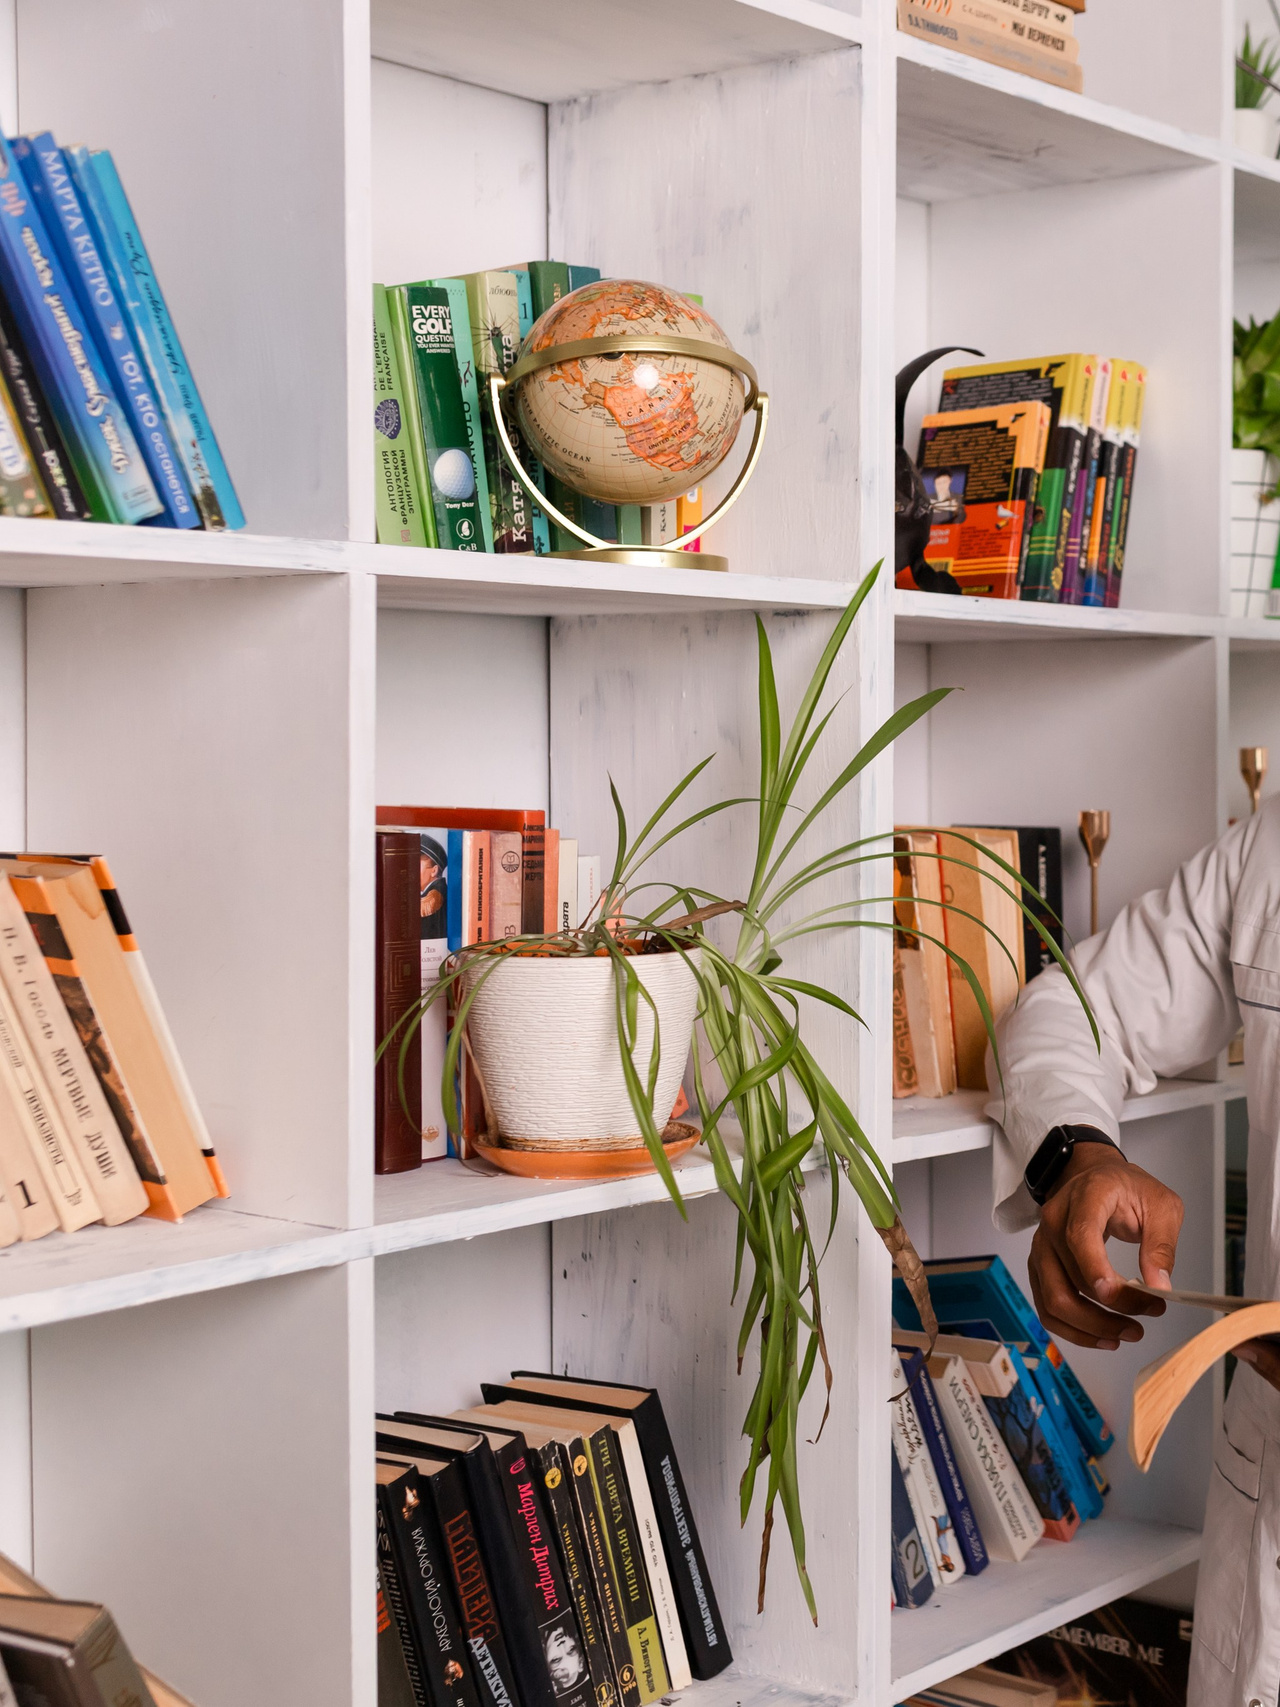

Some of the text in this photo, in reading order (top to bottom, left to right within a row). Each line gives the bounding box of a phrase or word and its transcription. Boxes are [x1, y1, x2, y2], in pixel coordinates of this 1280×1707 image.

[42, 150, 112, 307] МАРТА КЕТРО
[411, 305, 450, 318] EVERY
[413, 318, 453, 334] GOLF
[380, 376, 387, 391] DE
[381, 332, 394, 391] FRANÇAISE
[133, 394, 159, 429] КТО
[626, 380, 679, 417] CANADA
[533, 418, 560, 448] PACIFIC
[562, 448, 591, 463] OCEAN
[648, 437, 670, 450] UNITED
[382, 450, 397, 512] АНТОЛОГИЯ
[392, 450, 408, 525] ФРАНЦУЗСКОЙ
[399, 449, 414, 514] ЭПИГРАММЫ
[511, 480, 527, 542] Катя
[458, 543, 477, 552] C&B
[23, 1088, 65, 1165] ГИМНАЗИСТЫ
[52, 1048, 94, 1123] МЕРТВЫЕ
[84, 1131, 117, 1179] ДУШИ
[15, 1180, 38, 1210] 1
[948, 1375, 1008, 1503] ПЛЯСКА СМЕРТИ
[517, 1481, 559, 1611] Марлен Дитрих
[588, 1511, 604, 1569] ПОЛИТИКА
[598, 1437, 640, 1602] ТРИ ЦВЕТА ВРЕМЕНИ
[563, 1523, 580, 1578] ПОЛИТИКА
[660, 1455, 719, 1647] АВТОМАТИЗИРОВАННЫЙ ЭЛЕКТРОПРИВОД
[905, 1539, 924, 1580] 2
[411, 1527, 452, 1652] АРХЕОЛОГИЯ ОРУЖИЯ
[603, 1581, 620, 1635] ДЕТЕКТИВ
[578, 1593, 597, 1646] ДЕТЕКТИВ
[1044, 1626, 1165, 1667] EMEMBER ME
[600, 1684, 609, 1700] 1
[621, 1666, 632, 1681] 6
[640, 1638, 656, 1694] Виноградов
